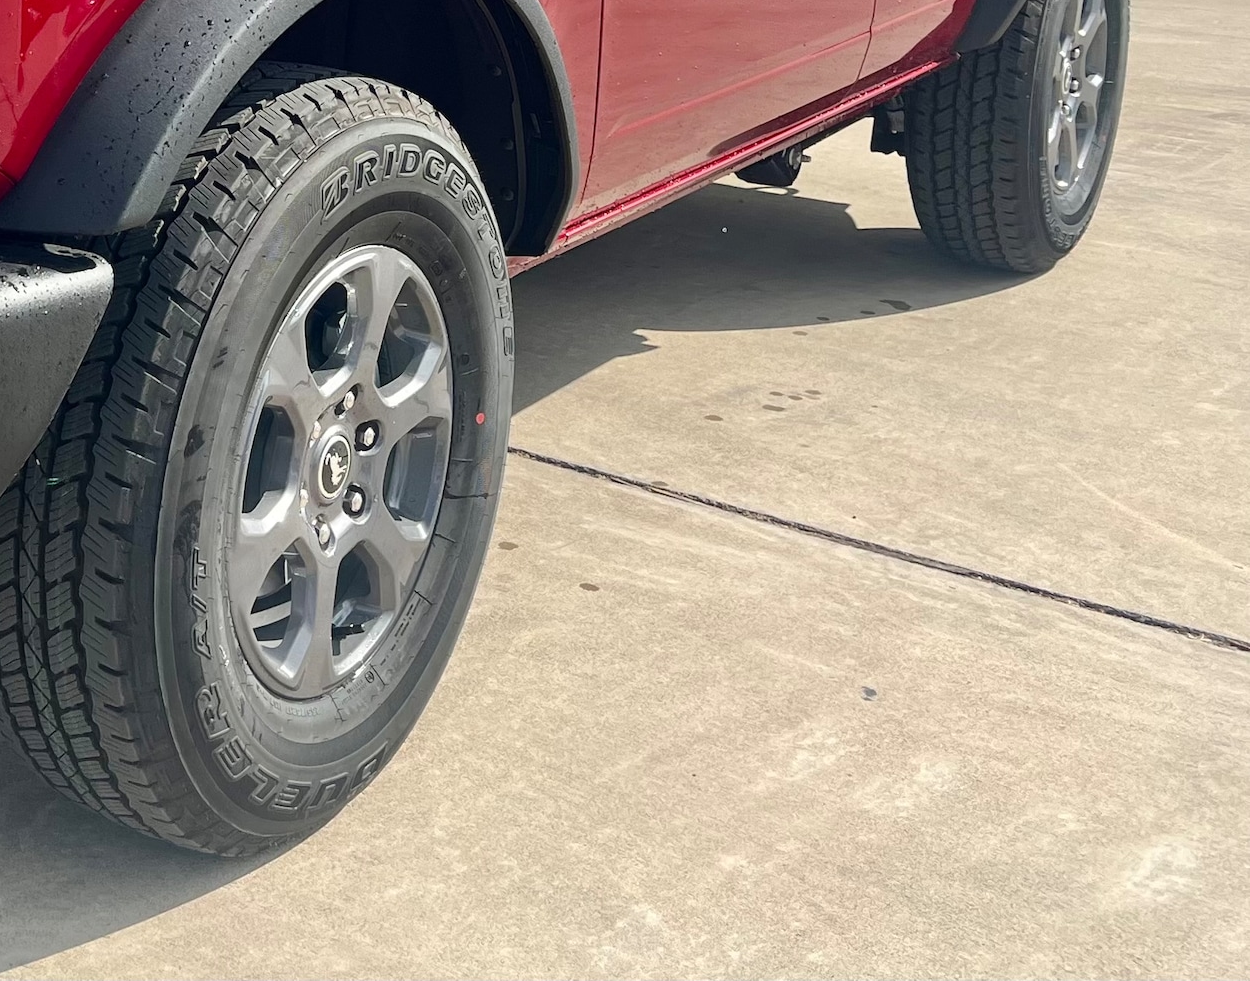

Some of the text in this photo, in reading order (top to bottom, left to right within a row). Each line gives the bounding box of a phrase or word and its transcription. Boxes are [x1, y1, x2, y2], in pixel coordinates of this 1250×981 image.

[320, 143, 514, 357] BRIDGESTONE
[190, 546, 389, 812] DUELER A/T
